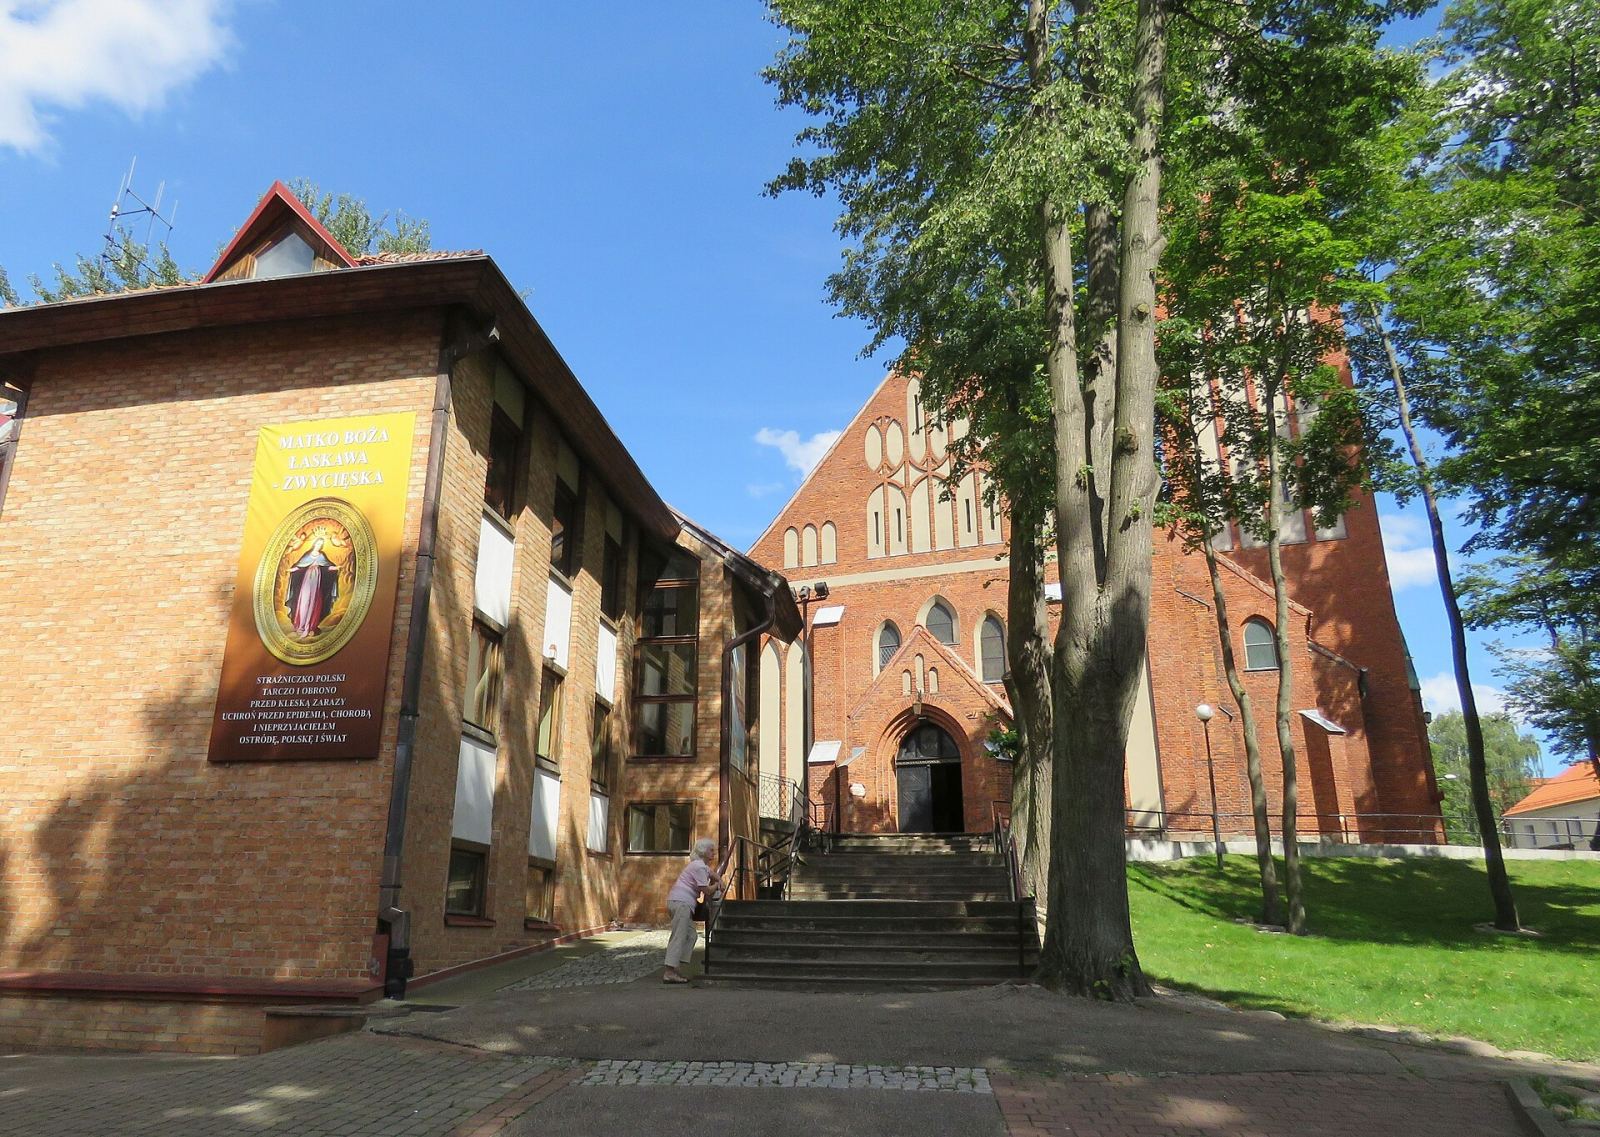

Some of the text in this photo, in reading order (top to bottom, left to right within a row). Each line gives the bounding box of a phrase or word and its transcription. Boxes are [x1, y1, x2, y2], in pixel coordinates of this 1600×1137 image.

[280, 425, 389, 449] MATKO BOŻA
[288, 450, 368, 469] ŁASKAWA
[282, 471, 384, 491] ZWYCIĘSKA
[257, 674, 345, 684] STRAŻNICZKO POLSKI
[250, 700, 276, 708] PRZED
[312, 698, 346, 707] ZARAZY
[222, 711, 255, 720] UCHROŃ
[257, 711, 285, 719] PRZED
[331, 710, 371, 719] CHOROBĄ
[258, 723, 335, 731] NIEPRZYJACIELEM
[281, 735, 313, 744] POLSKĘ
[315, 735, 319, 743] I
[321, 733, 347, 742] ŚWIAT
